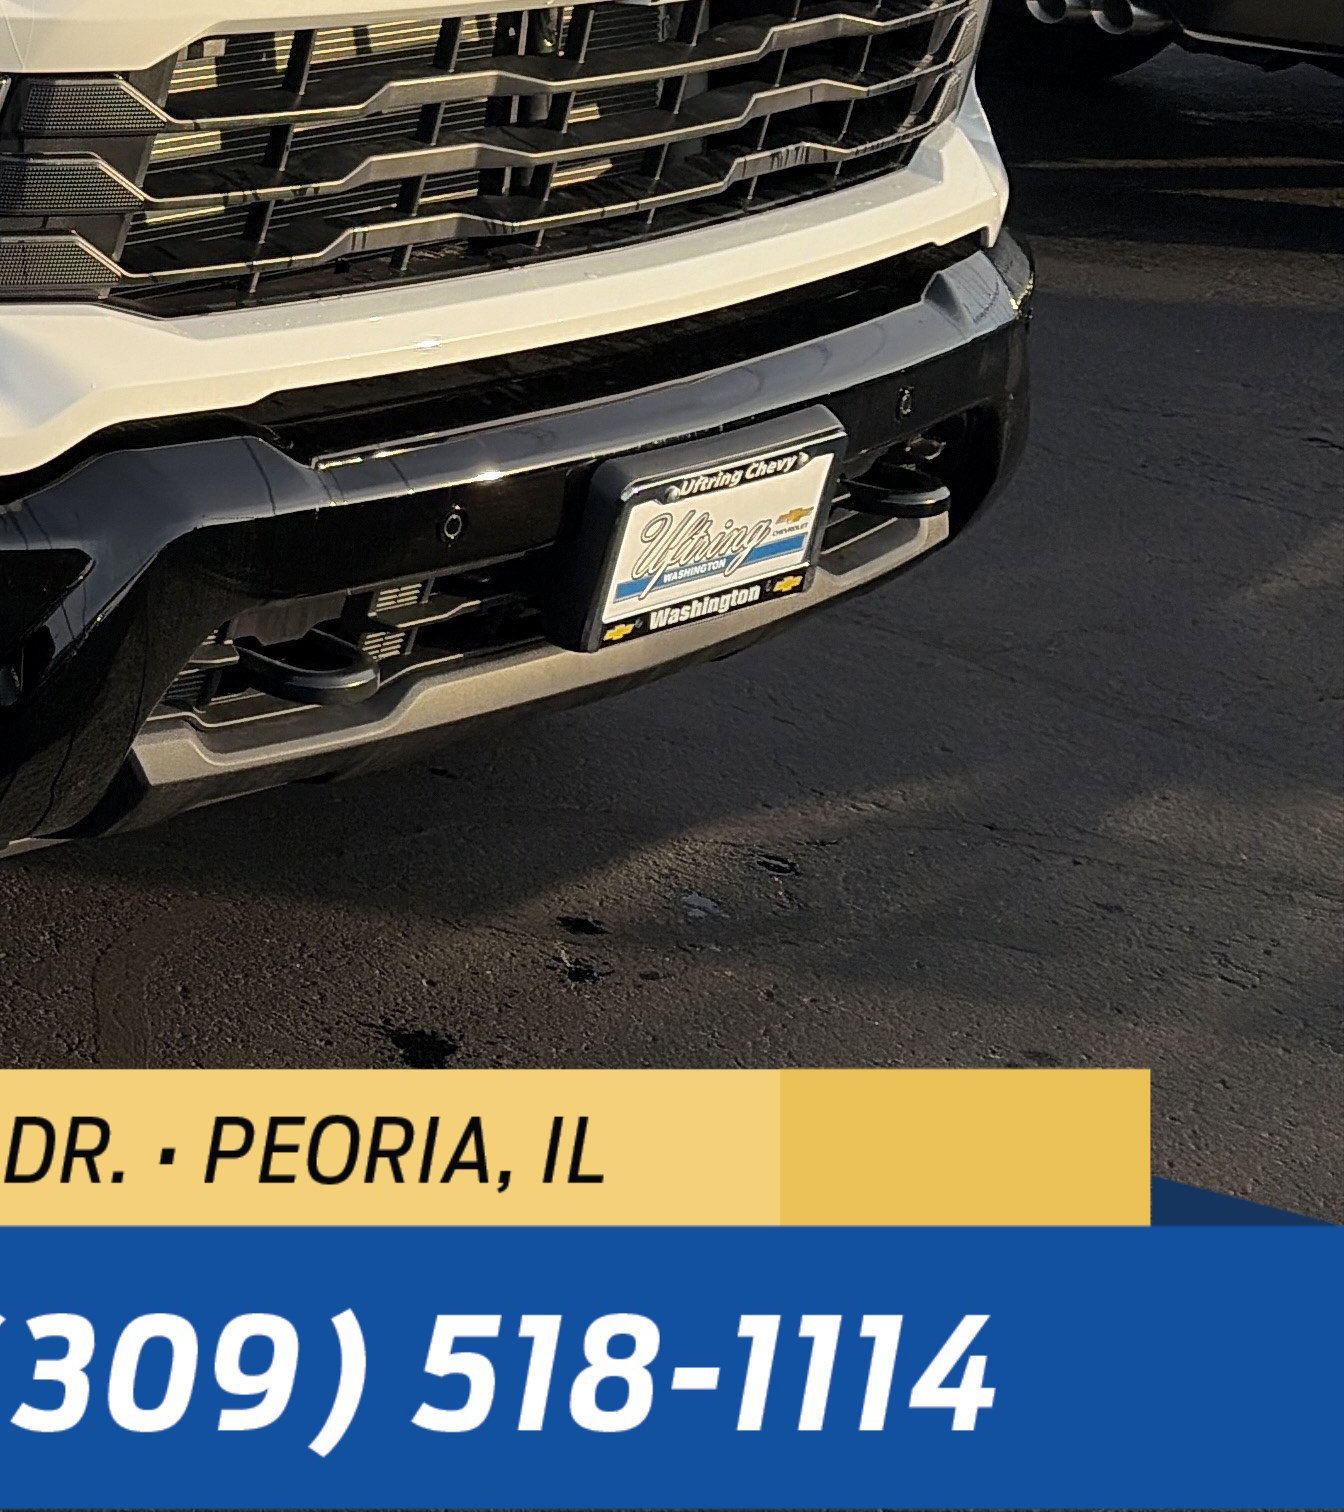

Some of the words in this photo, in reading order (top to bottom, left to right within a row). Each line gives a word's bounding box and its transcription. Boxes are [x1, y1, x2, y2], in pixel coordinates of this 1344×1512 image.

[679, 469, 744, 496] Uftring
[745, 455, 797, 479] Chevy
[632, 509, 772, 601] Uftring
[663, 558, 727, 583] WASHINGTON
[650, 585, 761, 630] Washington
